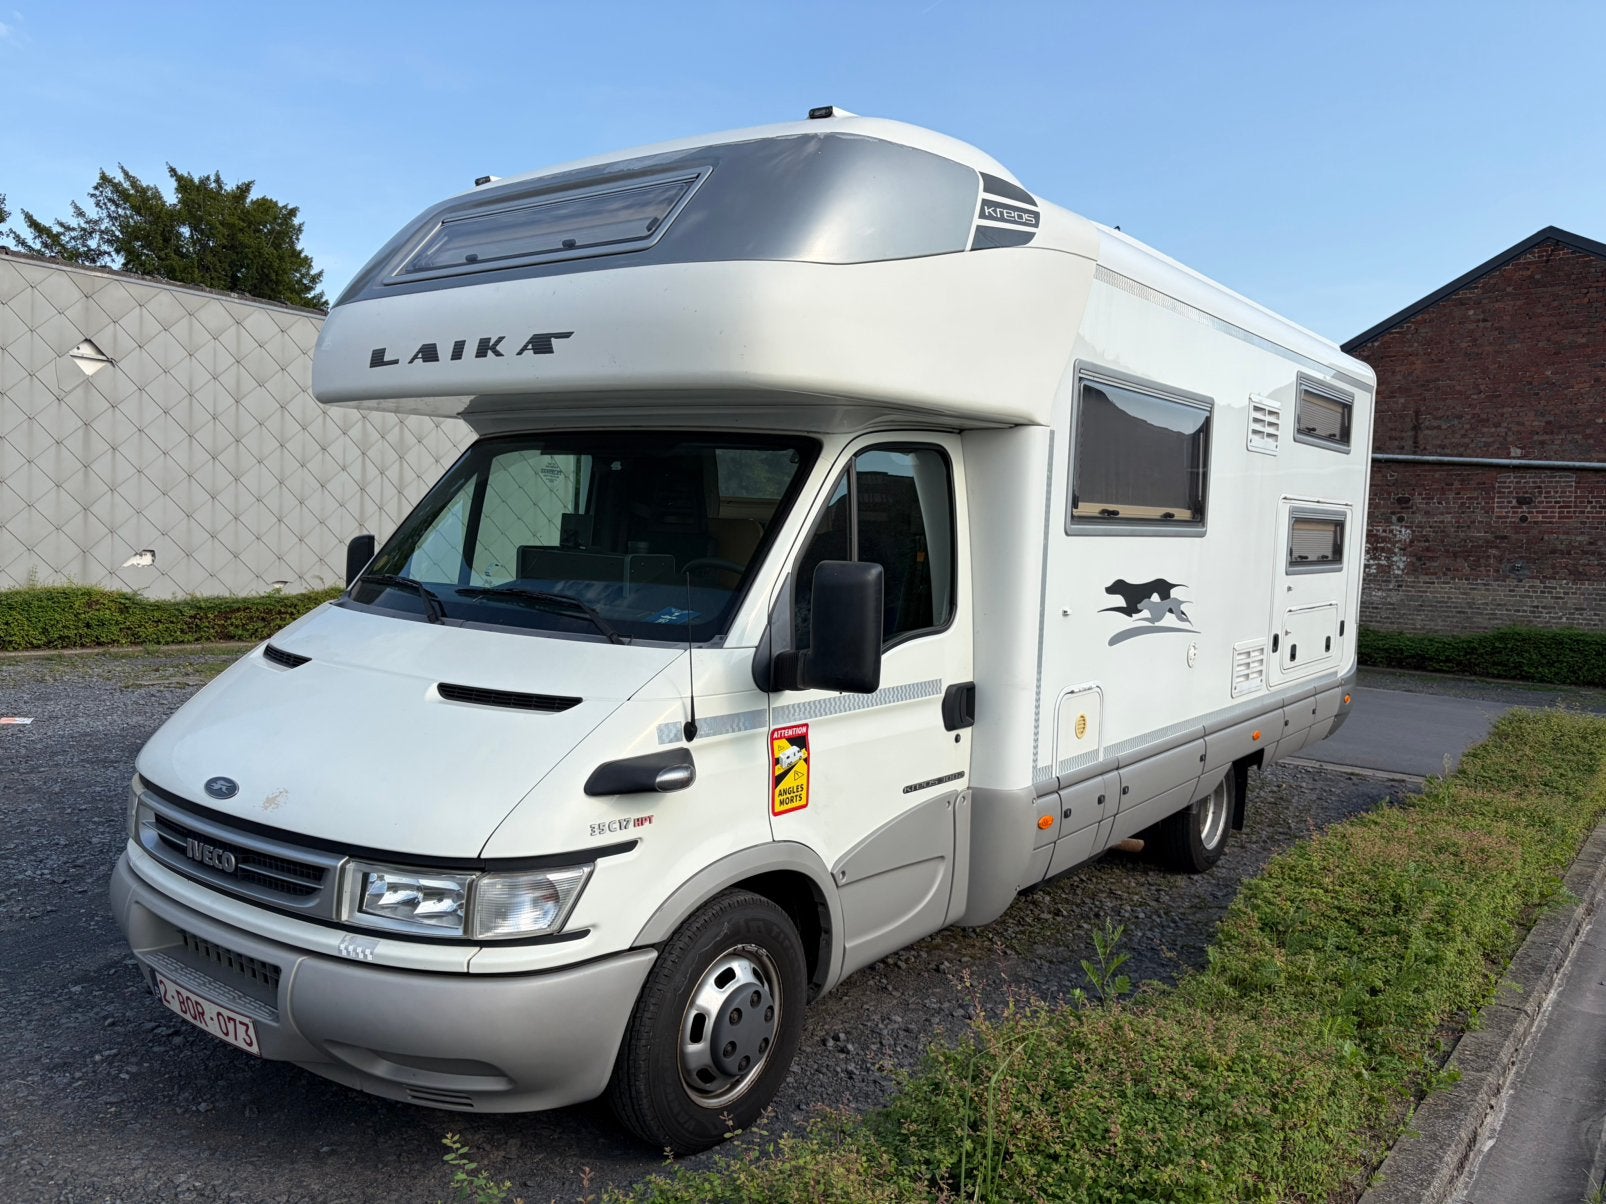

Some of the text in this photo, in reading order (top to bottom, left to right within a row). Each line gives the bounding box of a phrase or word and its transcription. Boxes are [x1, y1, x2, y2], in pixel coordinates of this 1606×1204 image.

[369, 331, 575, 369] LAIKA
[773, 725, 808, 739] ATTENTION
[778, 783, 804, 797] ANGLES
[779, 793, 803, 807] MORTS
[186, 838, 236, 873] IVECO
